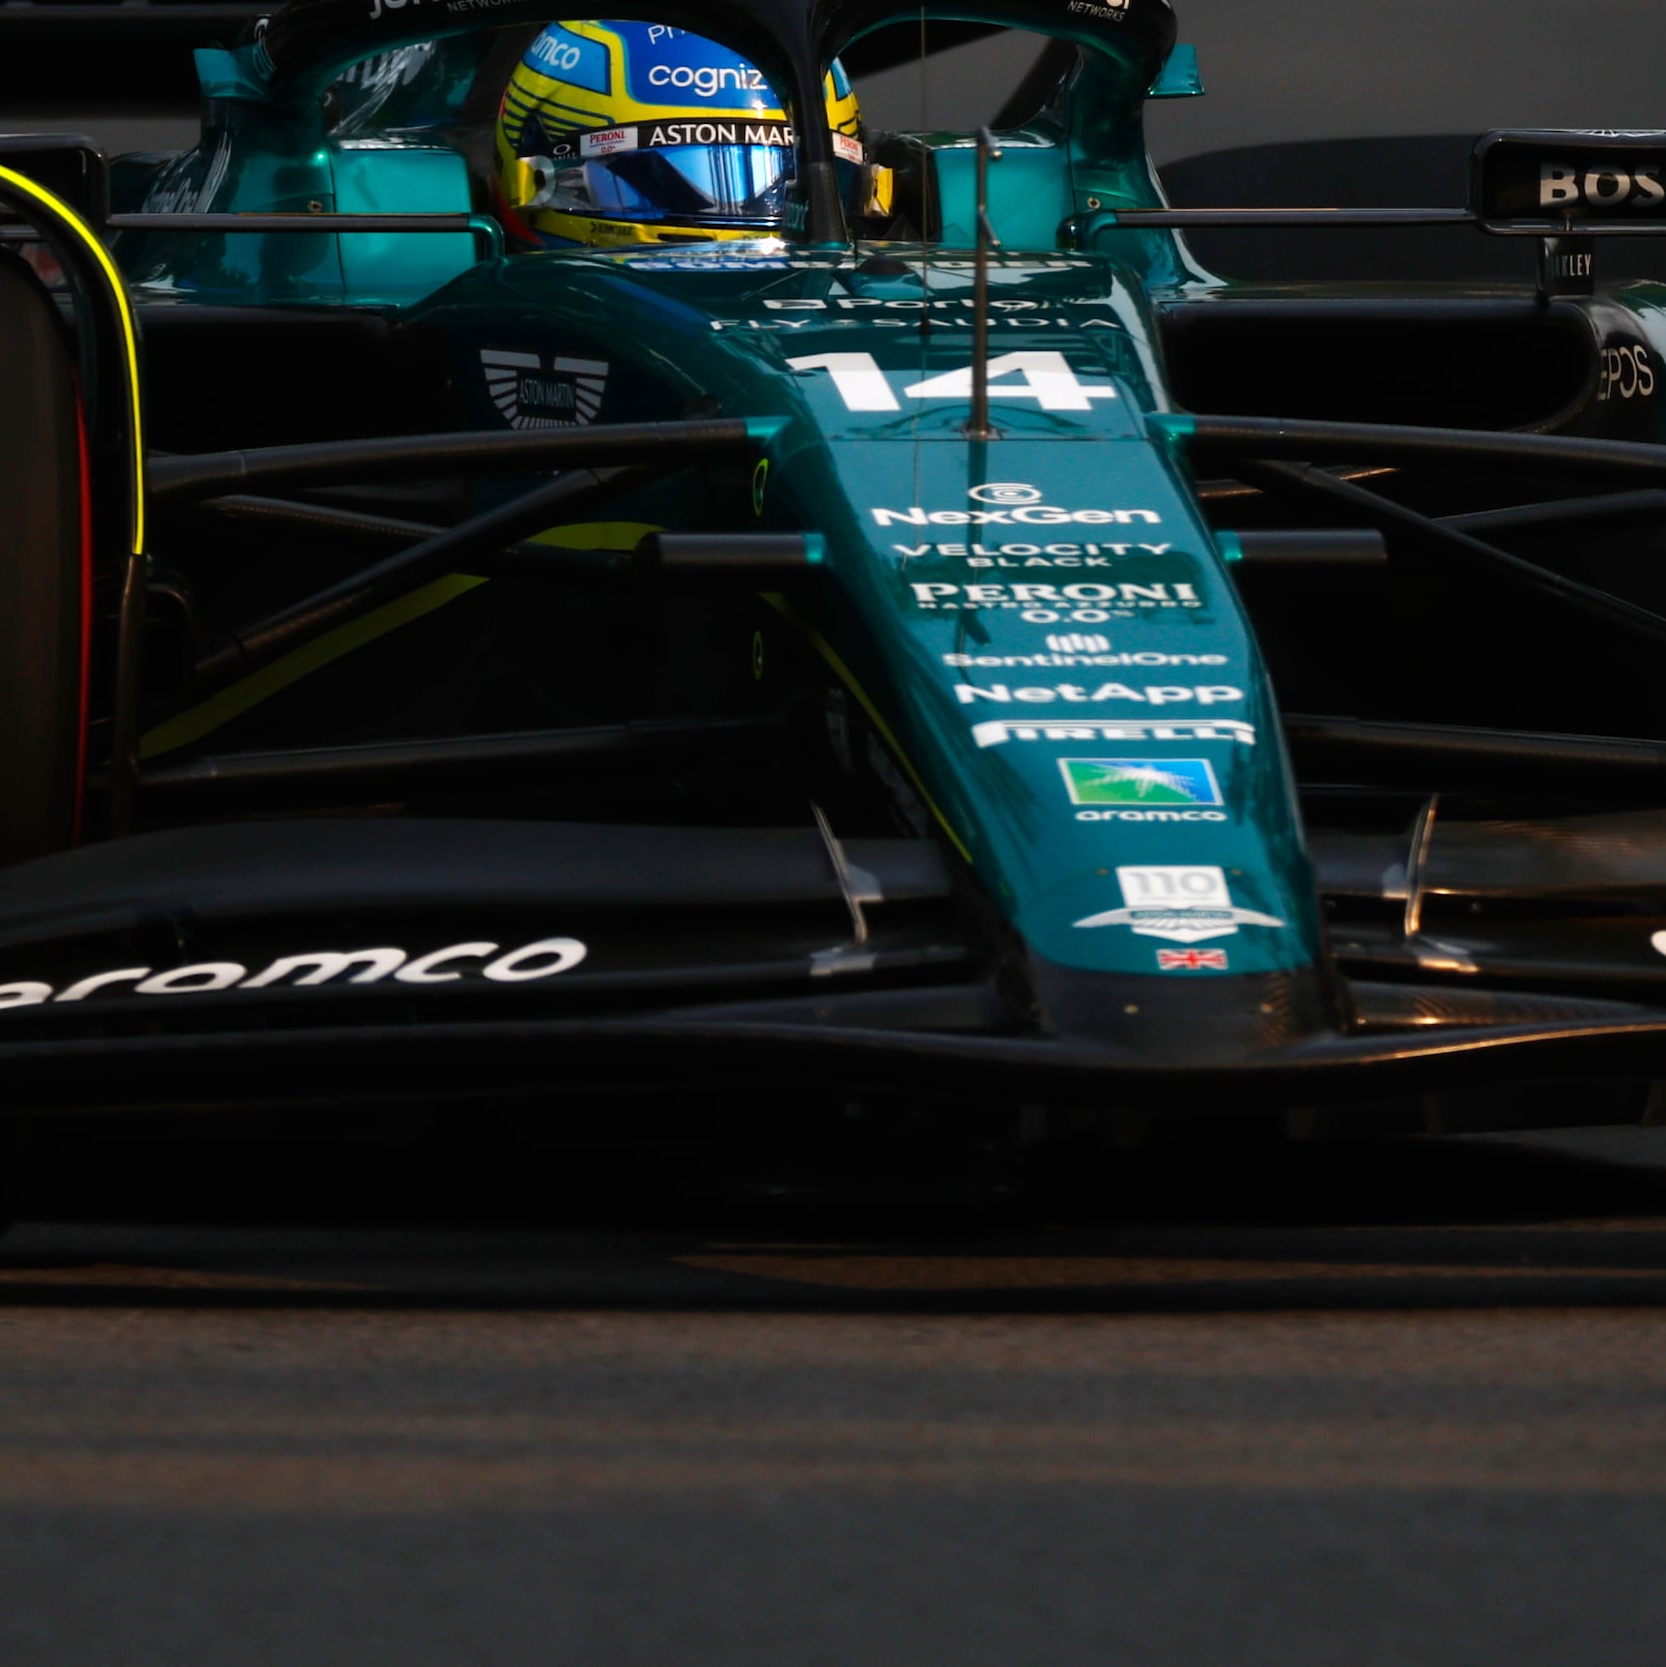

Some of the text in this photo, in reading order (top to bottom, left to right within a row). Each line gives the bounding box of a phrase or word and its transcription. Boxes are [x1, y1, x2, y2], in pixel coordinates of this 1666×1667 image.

[1067, 0, 1126, 22] NETWORKS
[648, 63, 768, 97] cogniz
[589, 130, 626, 144] PERONI
[649, 123, 736, 146] ASTON
[744, 126, 795, 147] MAR
[709, 317, 1122, 331] FLY SAUDIA
[785, 350, 1117, 412] 14
[1597, 344, 1655, 401] EPOS
[519, 378, 576, 410] ASTON MARTIN
[871, 505, 1162, 526] NexGen
[892, 543, 1173, 557] VELOCITY
[966, 556, 1114, 568] BLACK
[909, 583, 1198, 602] PERONI
[941, 652, 1230, 668] SentinelOne
[953, 682, 1244, 705] NetApp
[971, 719, 1258, 749] PIRELLI
[1074, 809, 1229, 822] aramco
[1129, 872, 1219, 895] 110
